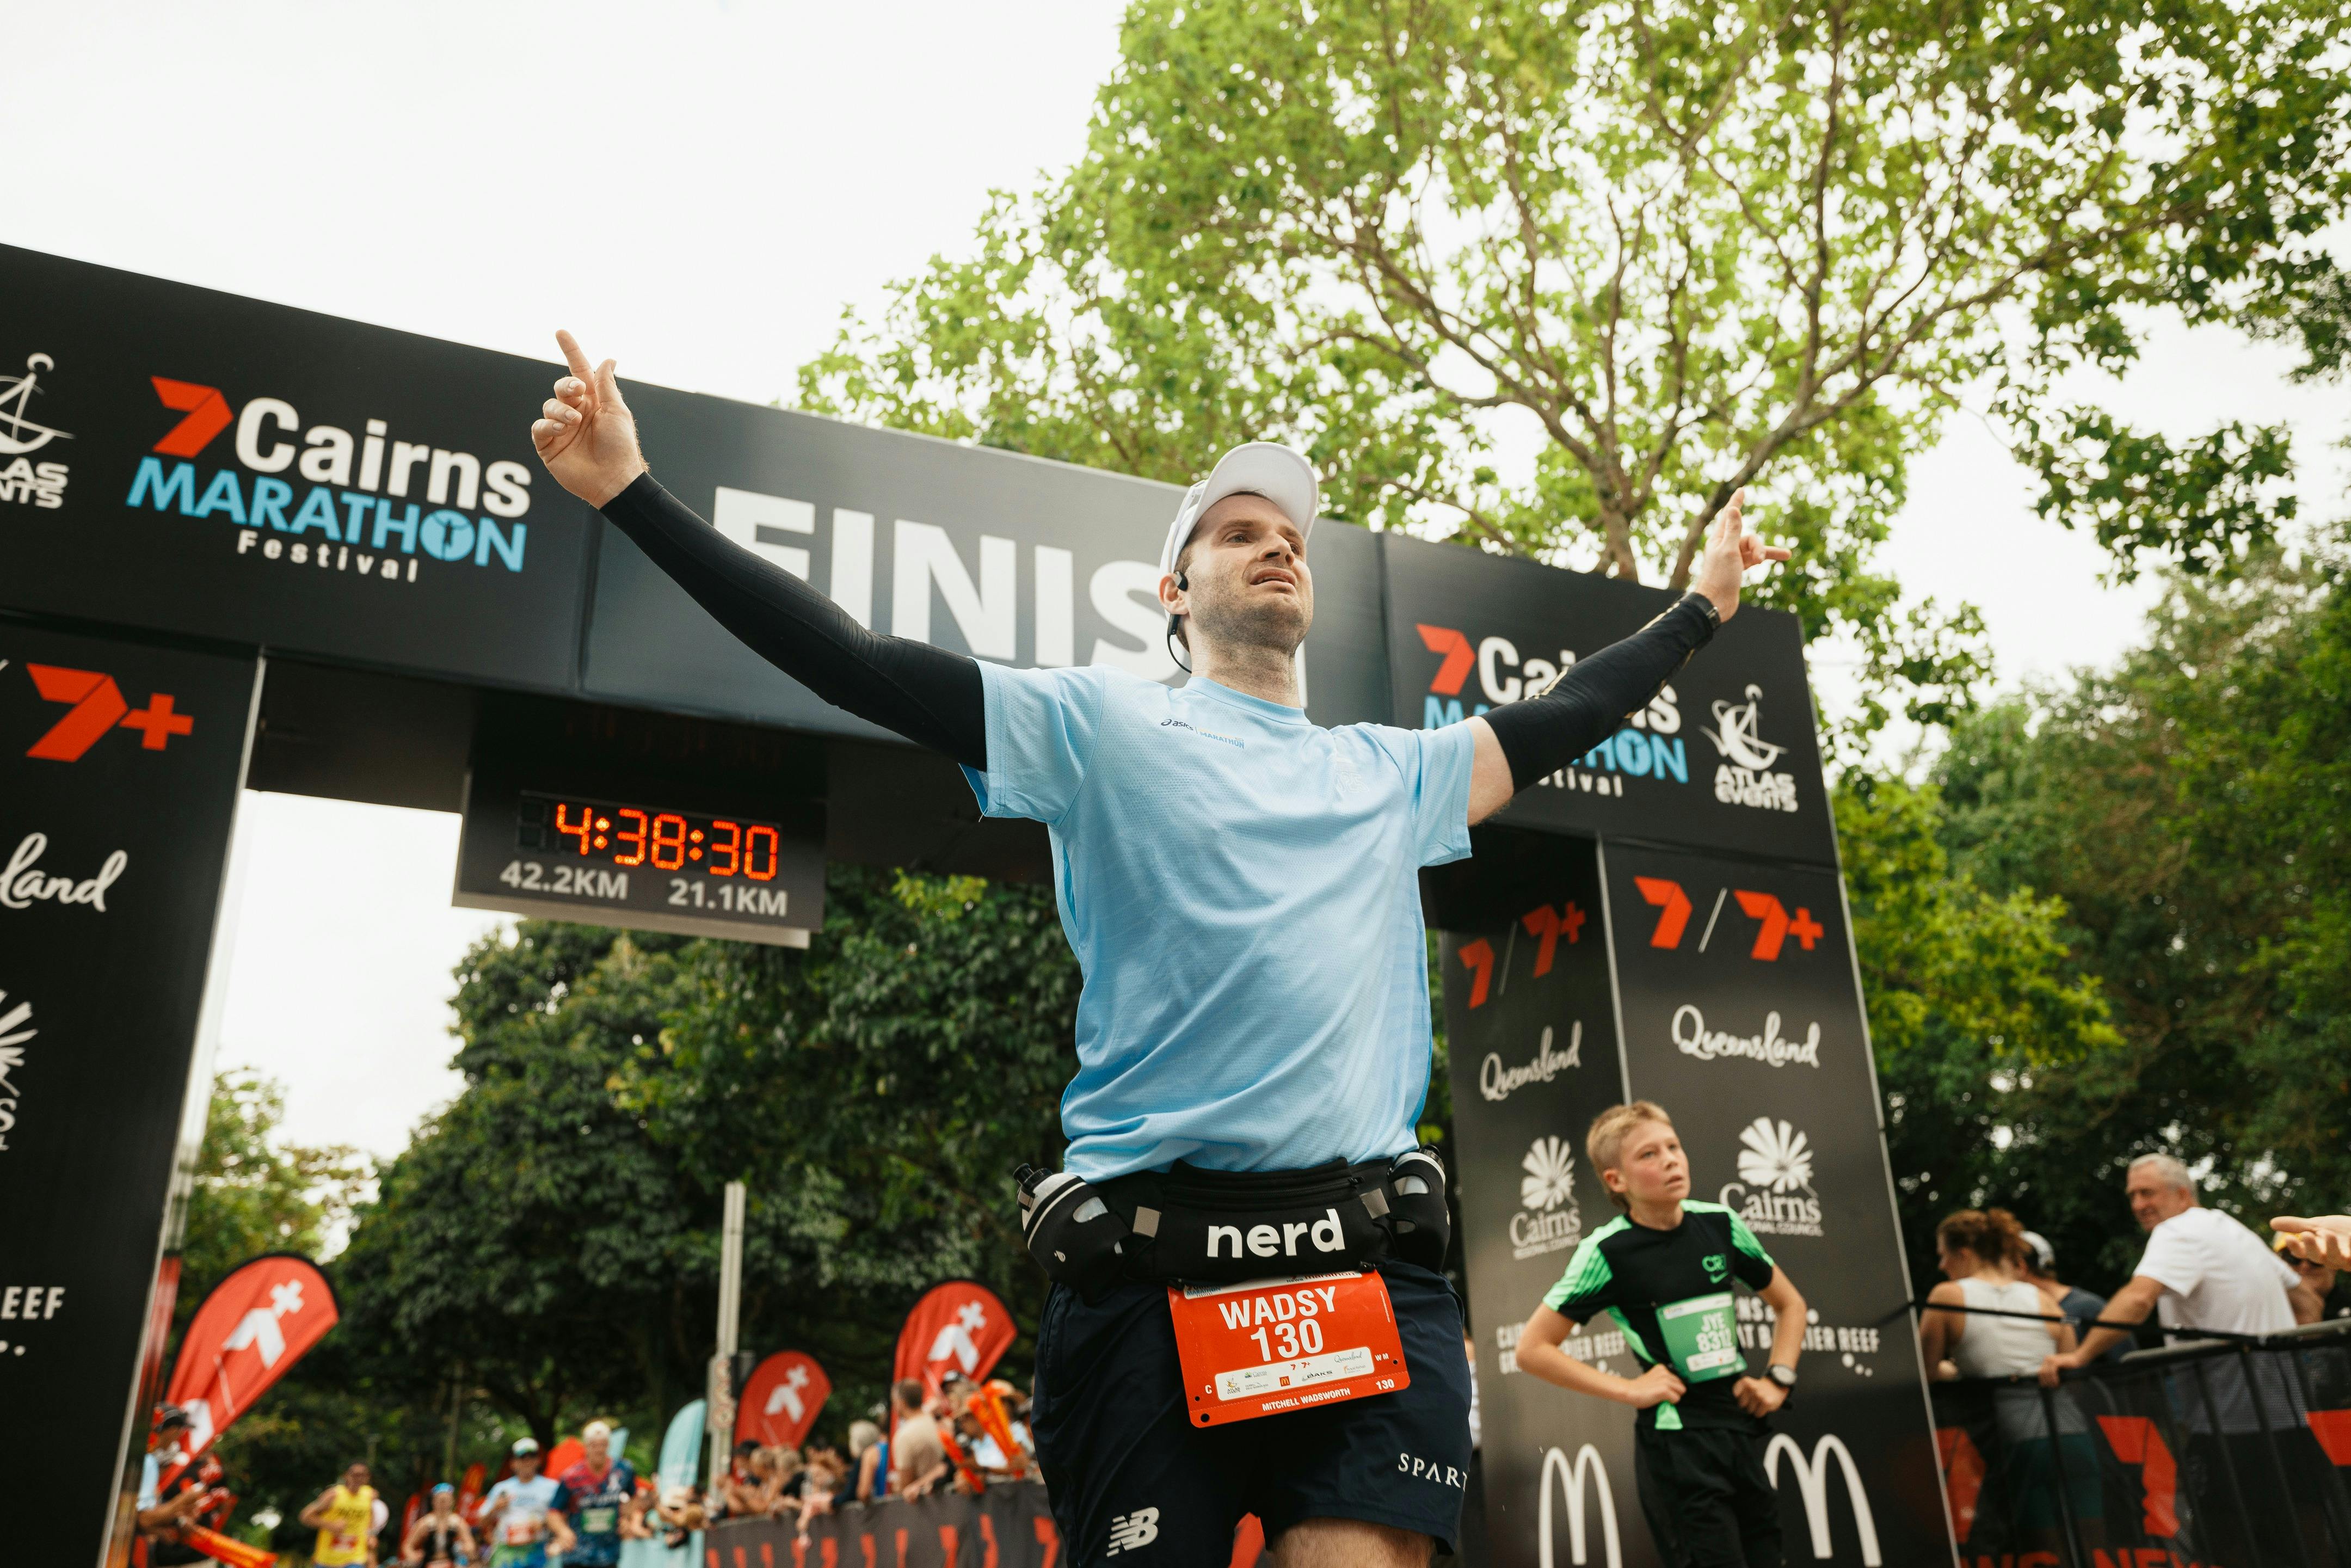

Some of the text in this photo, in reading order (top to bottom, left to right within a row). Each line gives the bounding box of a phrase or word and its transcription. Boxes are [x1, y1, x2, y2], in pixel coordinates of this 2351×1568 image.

[236, 397, 532, 518] Cairns
[126, 455, 528, 573] MARATHON
[237, 529, 418, 583] Festival
[713, 486, 1307, 709] FINIS
[1172, 720, 1194, 731] asics
[1199, 731, 1245, 749] MARATHON
[556, 803, 779, 882] 4:38:30
[500, 860, 787, 917] 42.2KM 21.1KM
[1670, 1004, 1821, 1069] Queensland
[1479, 1019, 1583, 1102] Queensland
[1719, 1182, 1823, 1223] Cairns
[1207, 1208, 1346, 1258] nerd
[1509, 1207, 1582, 1249] Cairns
[1217, 1286, 1336, 1330] WADSY
[1250, 1318, 1324, 1362] 130
[1204, 1384, 1213, 1394] C
[1262, 1387, 1351, 1412] MITCHELL WADSWORTH
[1376, 1379, 1395, 1390] 130
